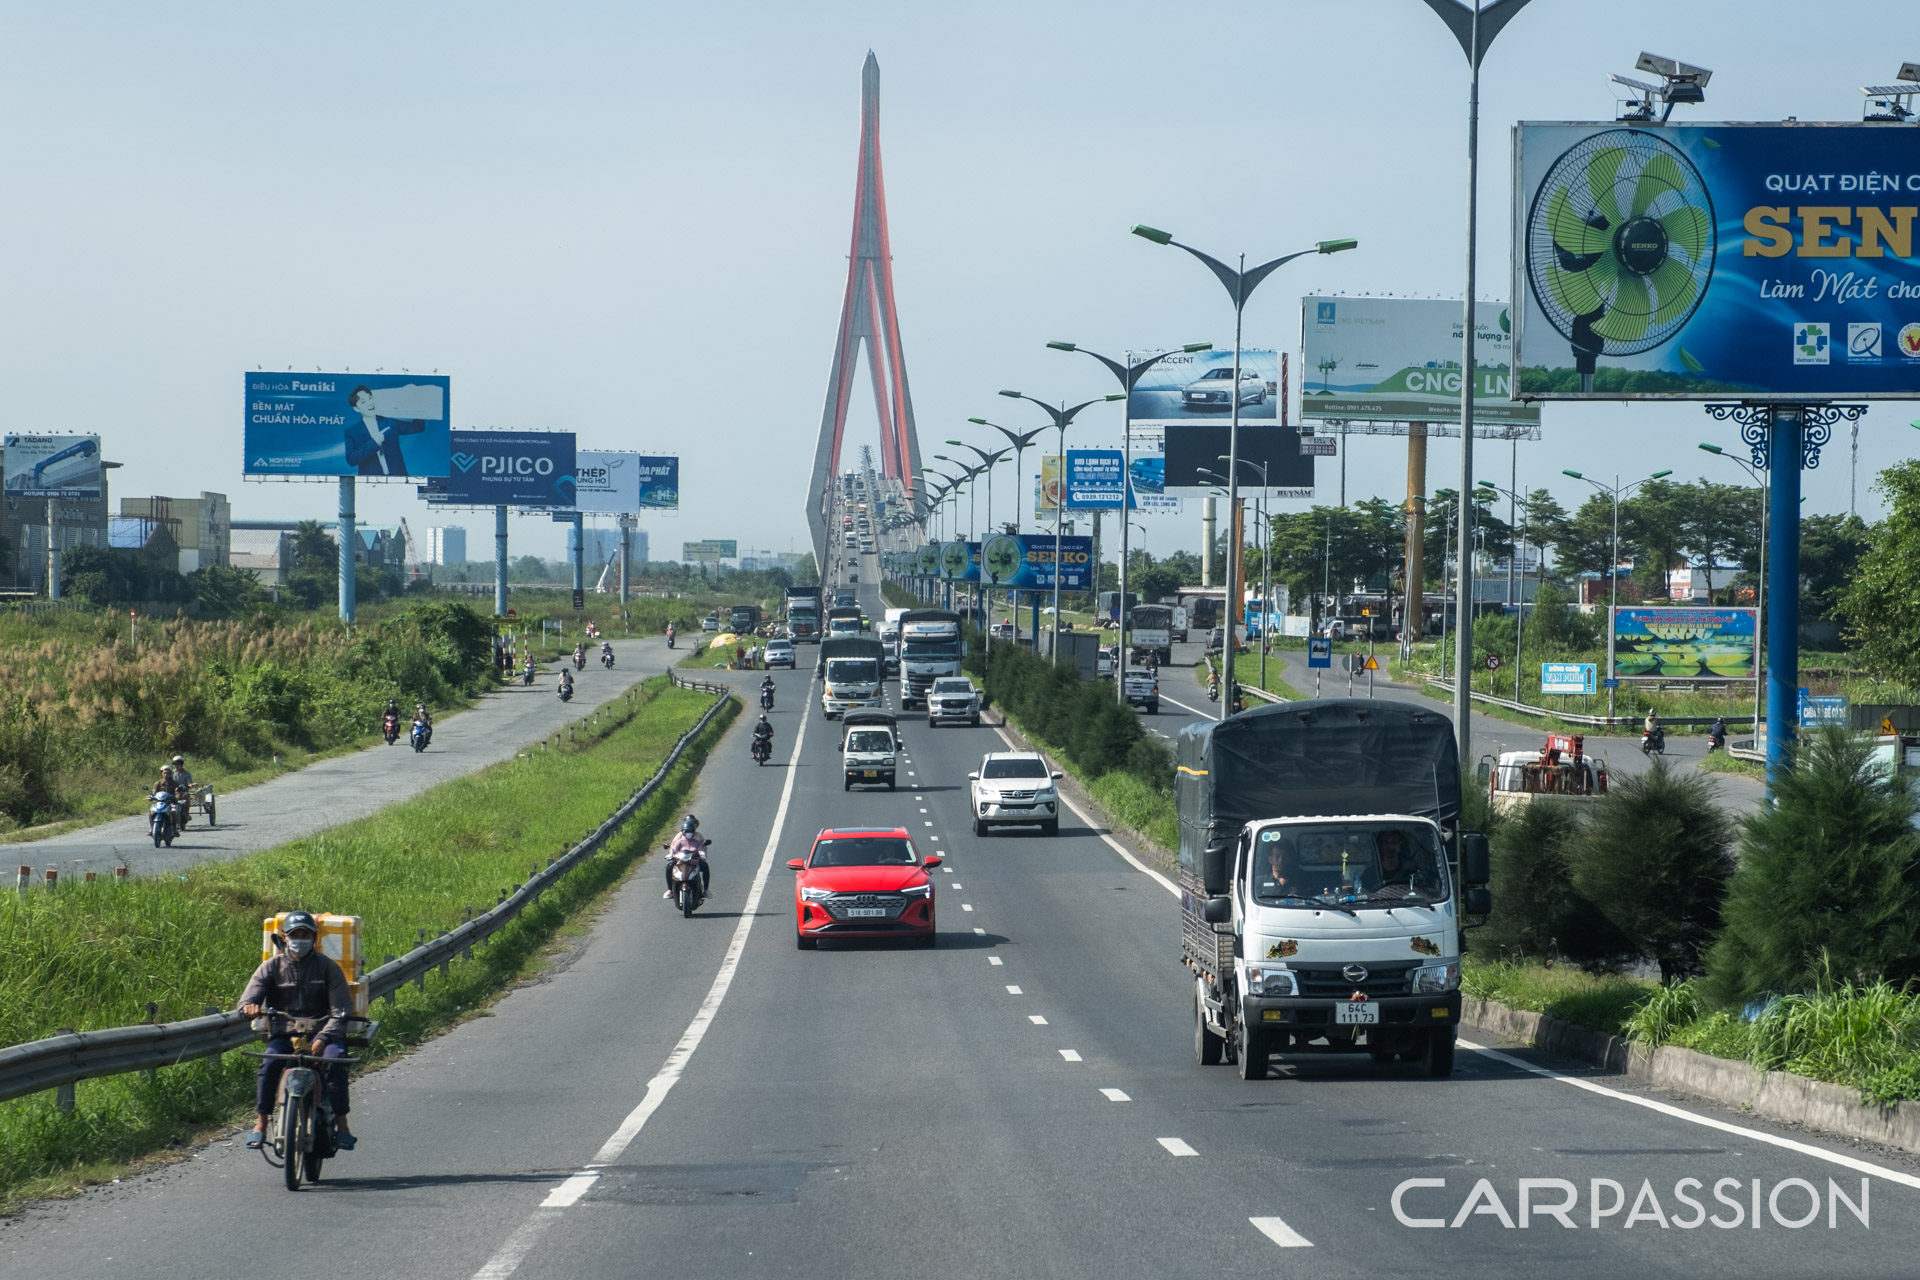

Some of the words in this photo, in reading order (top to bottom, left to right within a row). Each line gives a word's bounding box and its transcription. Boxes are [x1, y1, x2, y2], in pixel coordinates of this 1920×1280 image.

[1765, 174, 1834, 195] QUẠT
[1839, 171, 1900, 195] ĐIỆN
[1742, 205, 1919, 258] SEN
[1759, 278, 1804, 299] Làm
[1811, 268, 1878, 304] Mát
[1888, 280, 1920, 299] cho
[1477, 332, 1502, 342] lượng
[1131, 356, 1142, 364] All
[1161, 356, 1195, 365] ACCENT
[272, 382, 290, 391] HÒA
[291, 380, 336, 392] Funiki
[1405, 371, 1463, 392] CNG
[252, 400, 272, 411] BỀN
[274, 402, 295, 411] MÁT
[1428, 406, 1451, 414] Website:
[1452, 408, 1511, 417] wwgvietnam.com
[252, 411, 290, 424] CHUẨN
[293, 413, 317, 425] HÒA
[319, 414, 345, 425] PHÁT
[481, 456, 554, 476] PJICO
[650, 464, 671, 476] PHÁT
[1348, 1004, 1367, 1013] 64C
[1342, 1014, 1375, 1023] 111.73
